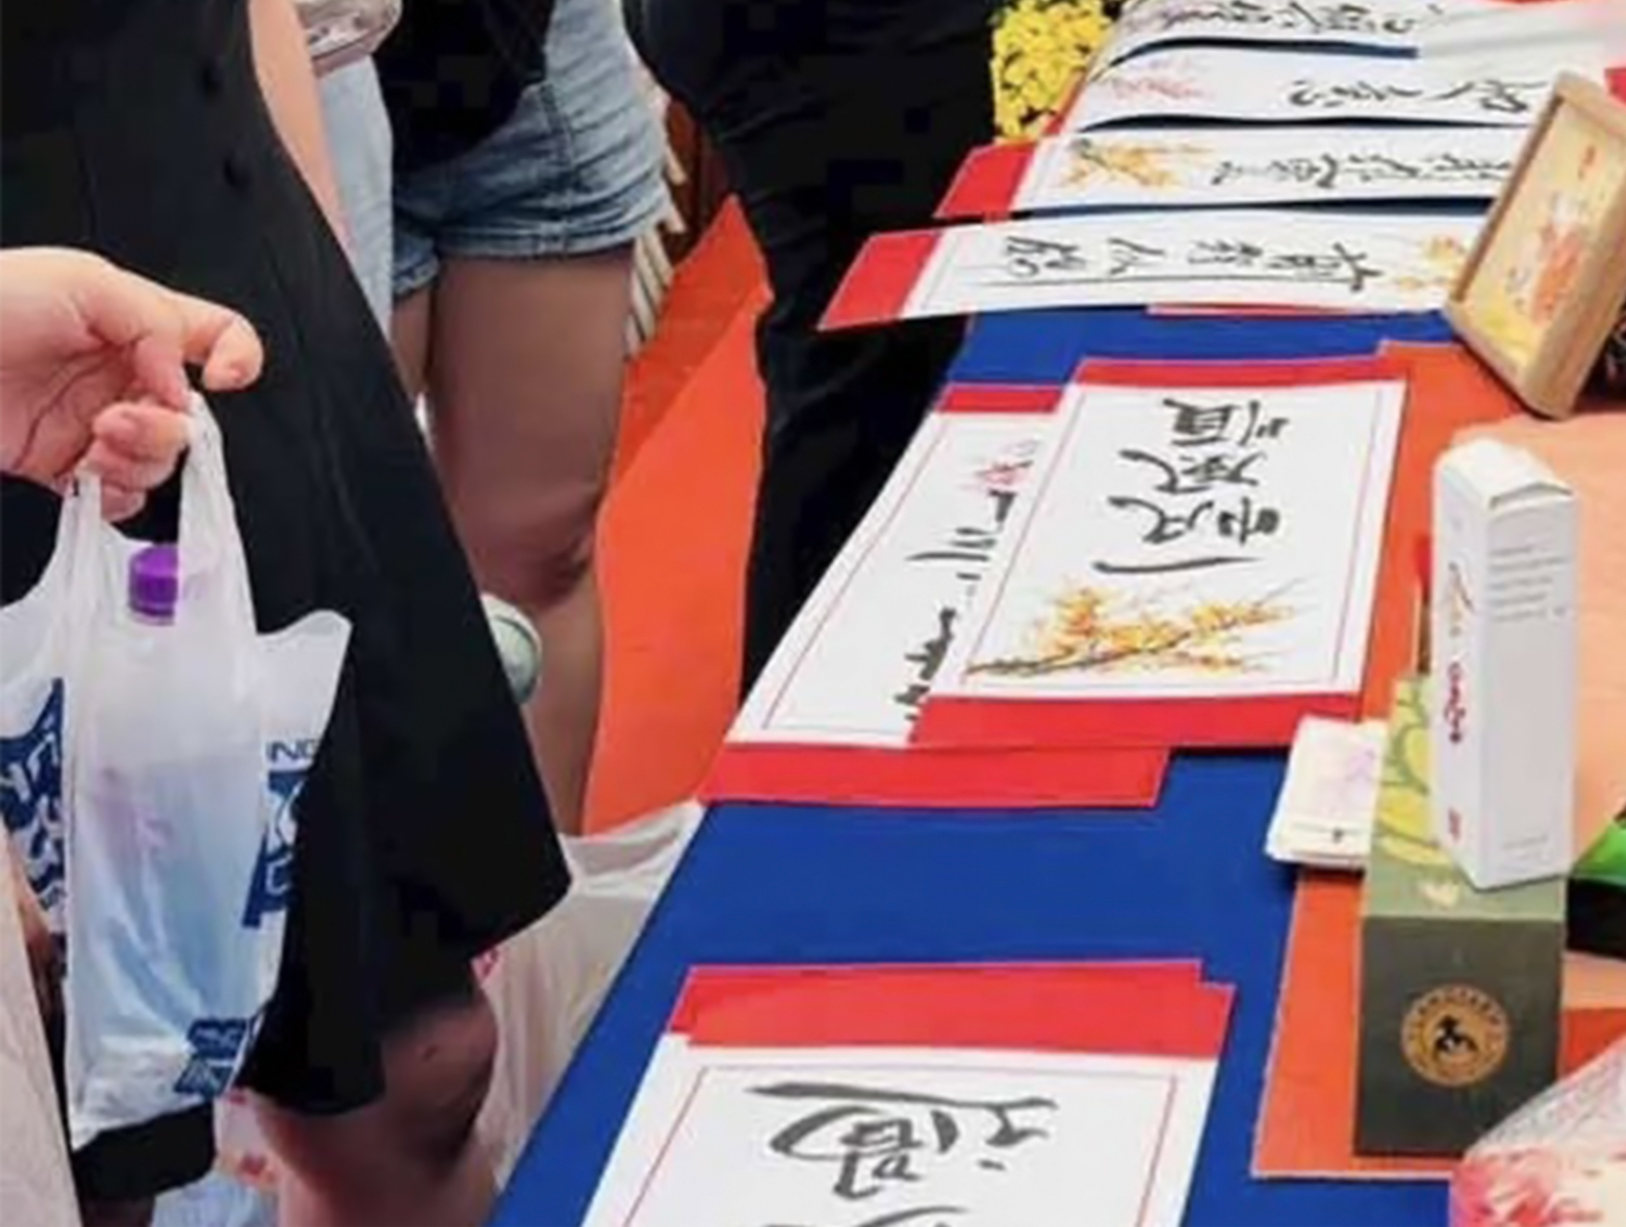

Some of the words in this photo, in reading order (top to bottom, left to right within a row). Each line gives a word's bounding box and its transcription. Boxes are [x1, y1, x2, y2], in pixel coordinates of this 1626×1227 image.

[1091, 397, 1290, 574] 一帆風順
[744, 1080, 1058, 1227] 過
